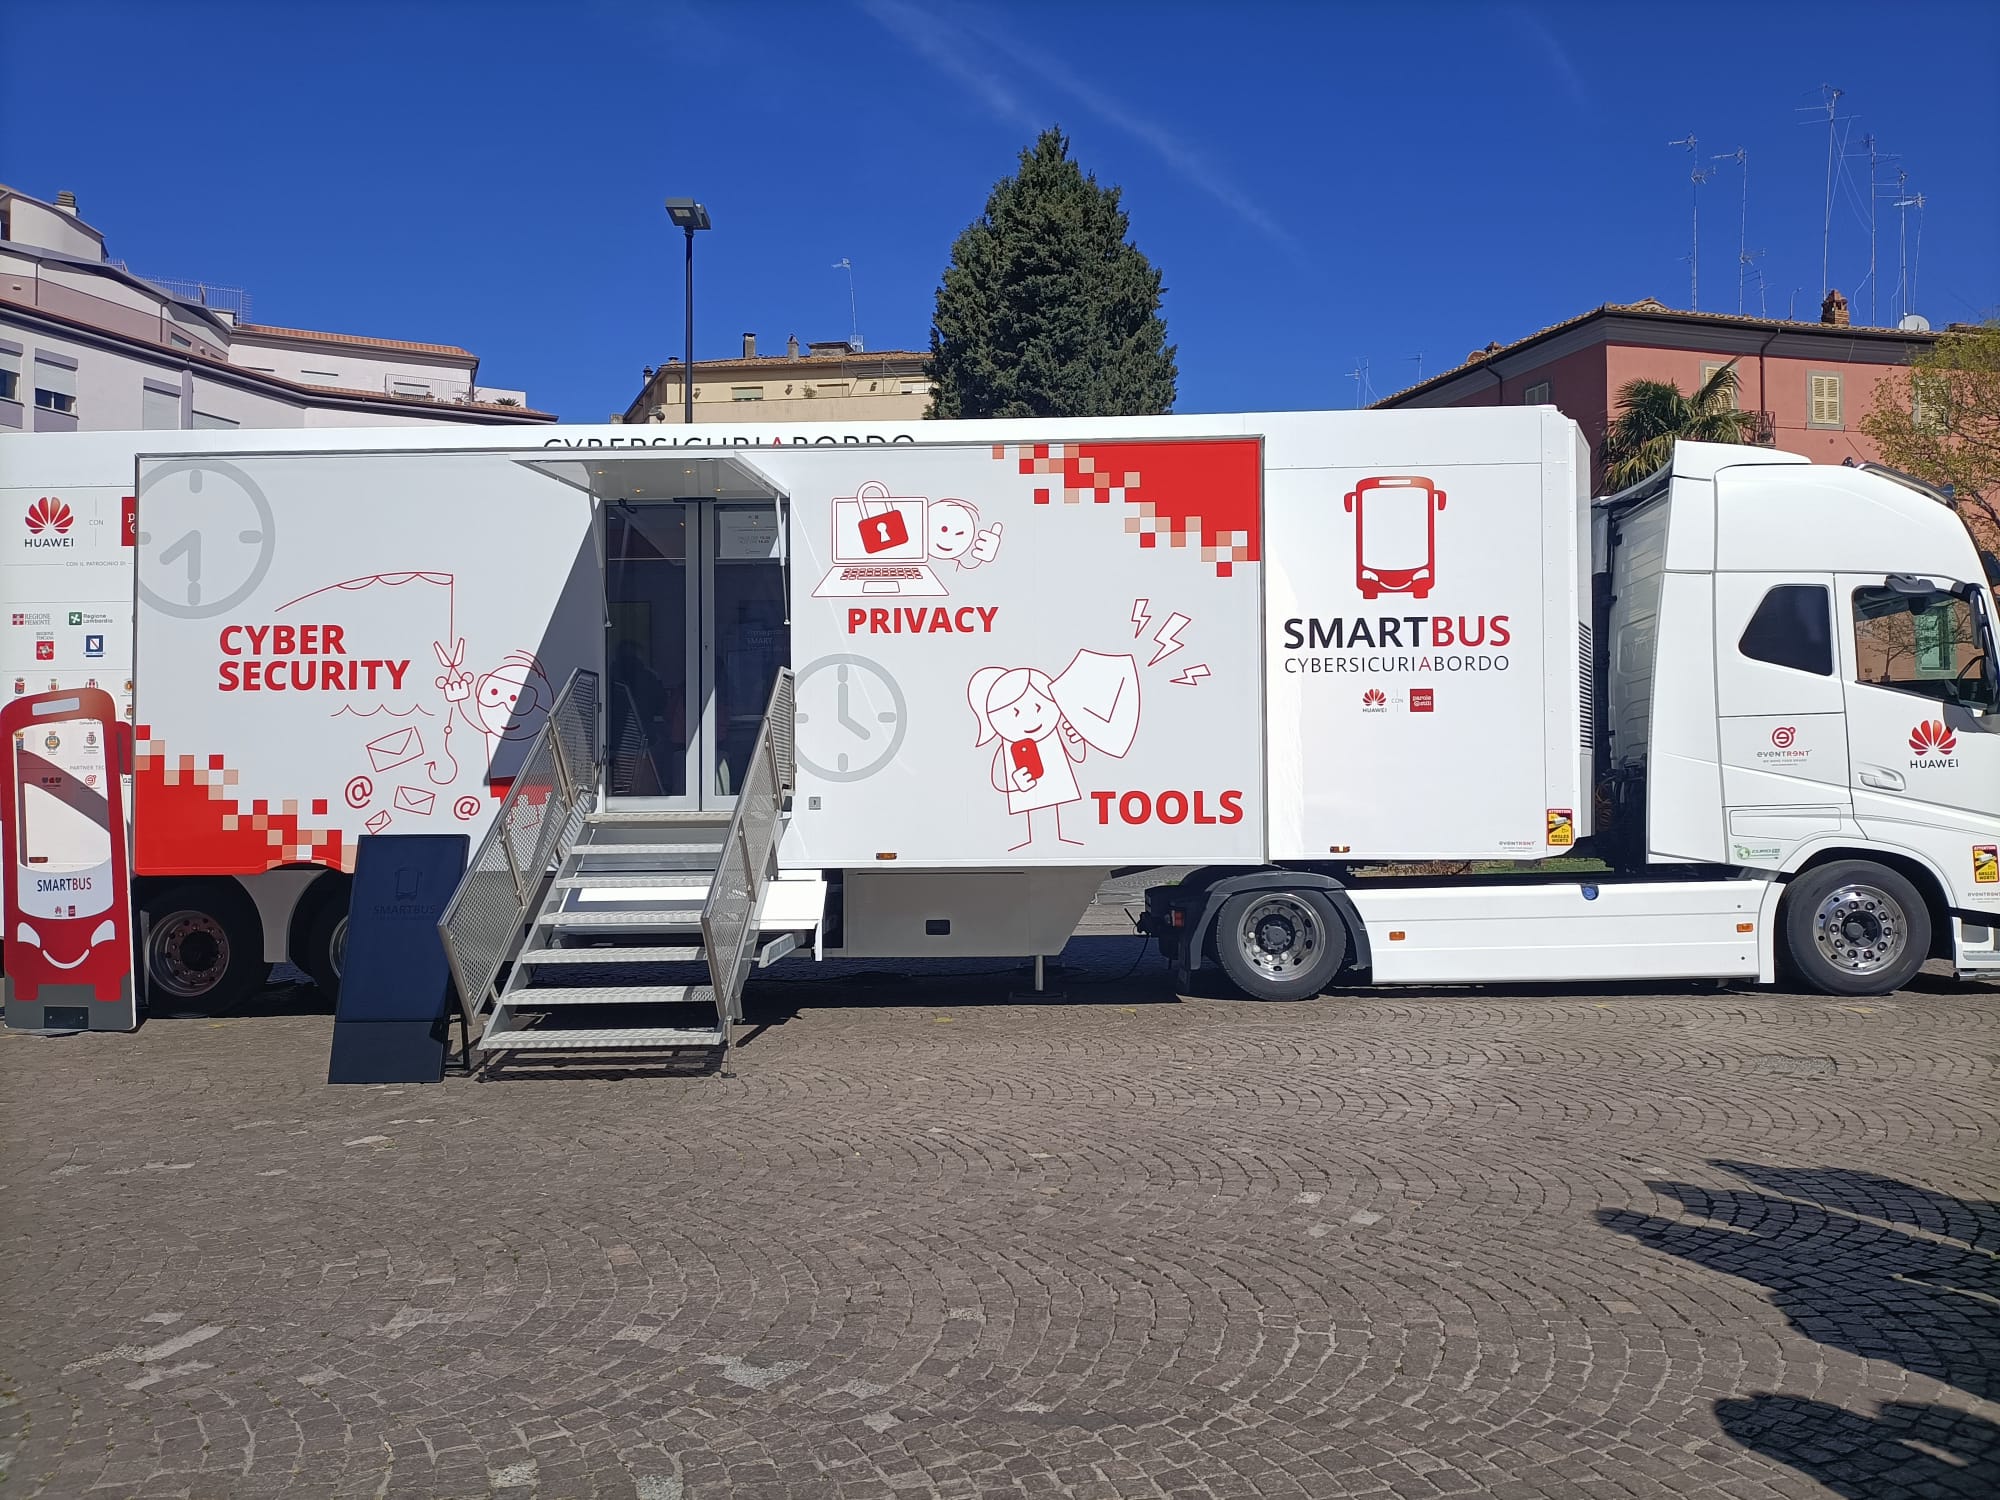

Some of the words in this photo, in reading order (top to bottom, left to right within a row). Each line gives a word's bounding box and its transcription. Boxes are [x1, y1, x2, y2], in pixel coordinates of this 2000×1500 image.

[24, 537, 74, 548] HUAWEI
[847, 606, 999, 634] PRIVACY
[1283, 614, 1511, 650] SMARTBUS
[219, 624, 347, 656] CYBER
[218, 659, 411, 692] SECURITY
[1284, 655, 1510, 674] CYBERSICURIABORDO
[1909, 758, 1959, 769] HUAWEI
[1091, 790, 1243, 825] TOOLS
[36, 877, 92, 892] SMARTBUS
